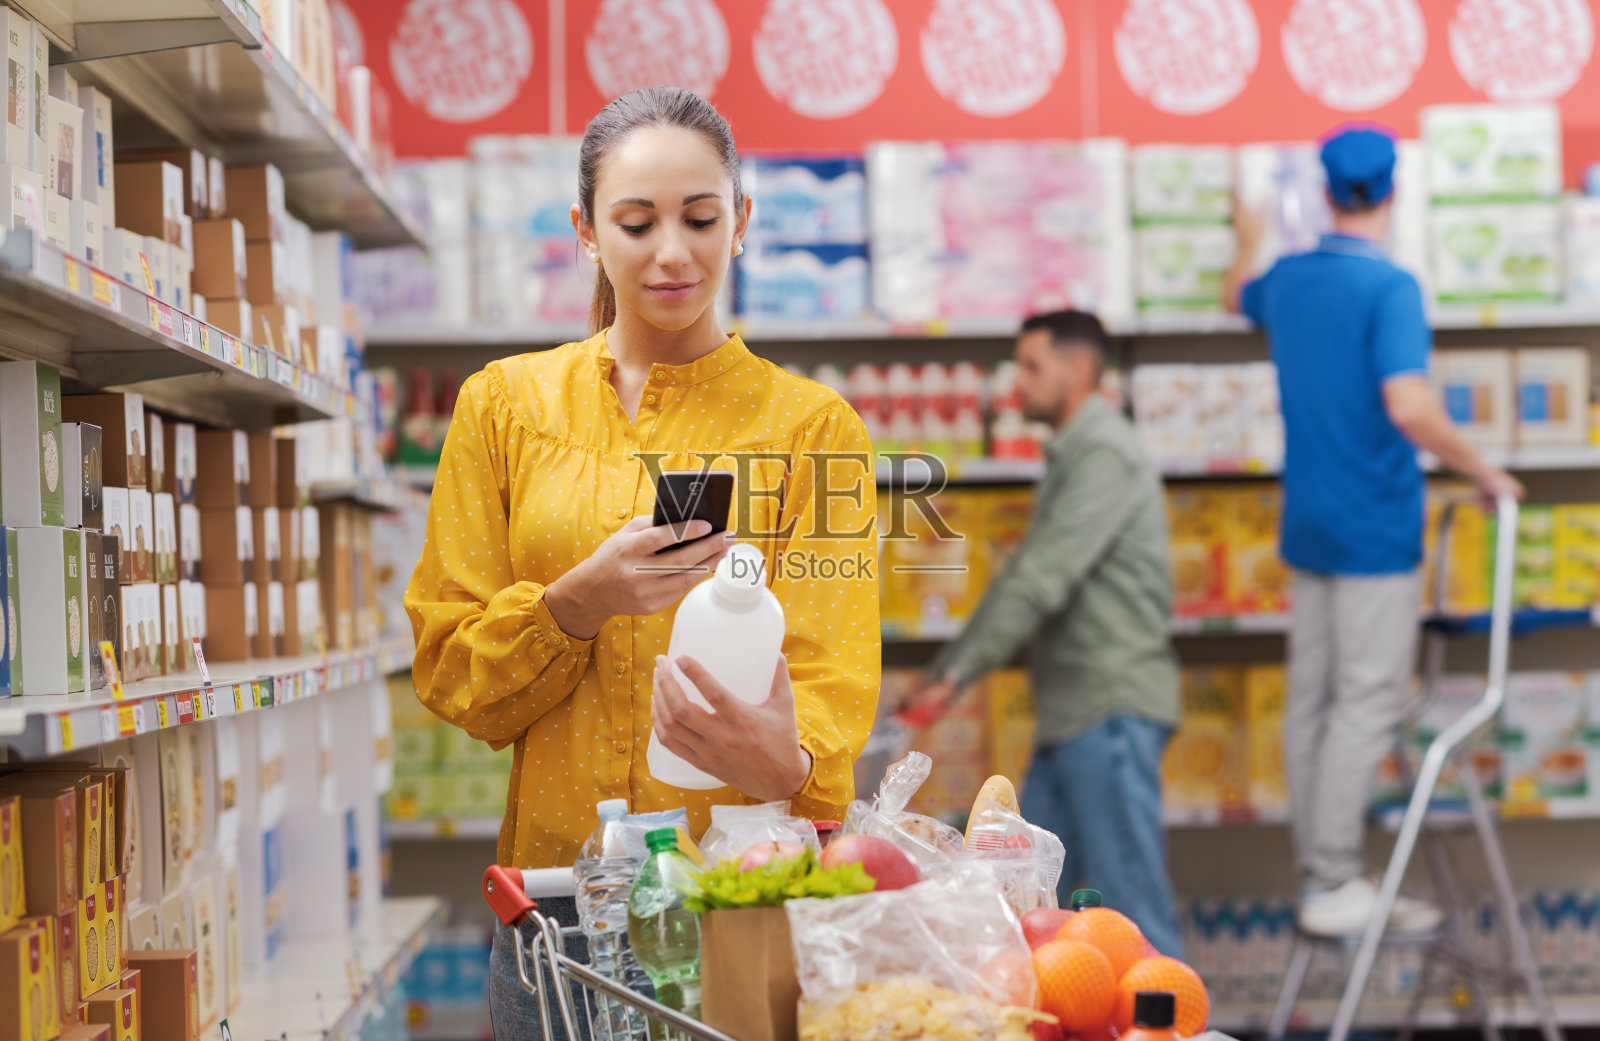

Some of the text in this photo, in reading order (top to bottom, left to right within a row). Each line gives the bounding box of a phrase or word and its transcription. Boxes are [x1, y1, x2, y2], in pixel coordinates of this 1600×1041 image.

[9, 29, 18, 47] RICE
[104, 553, 114, 565] BLACK
[69, 563, 78, 578] RICE
[104, 565, 115, 580] RICE
